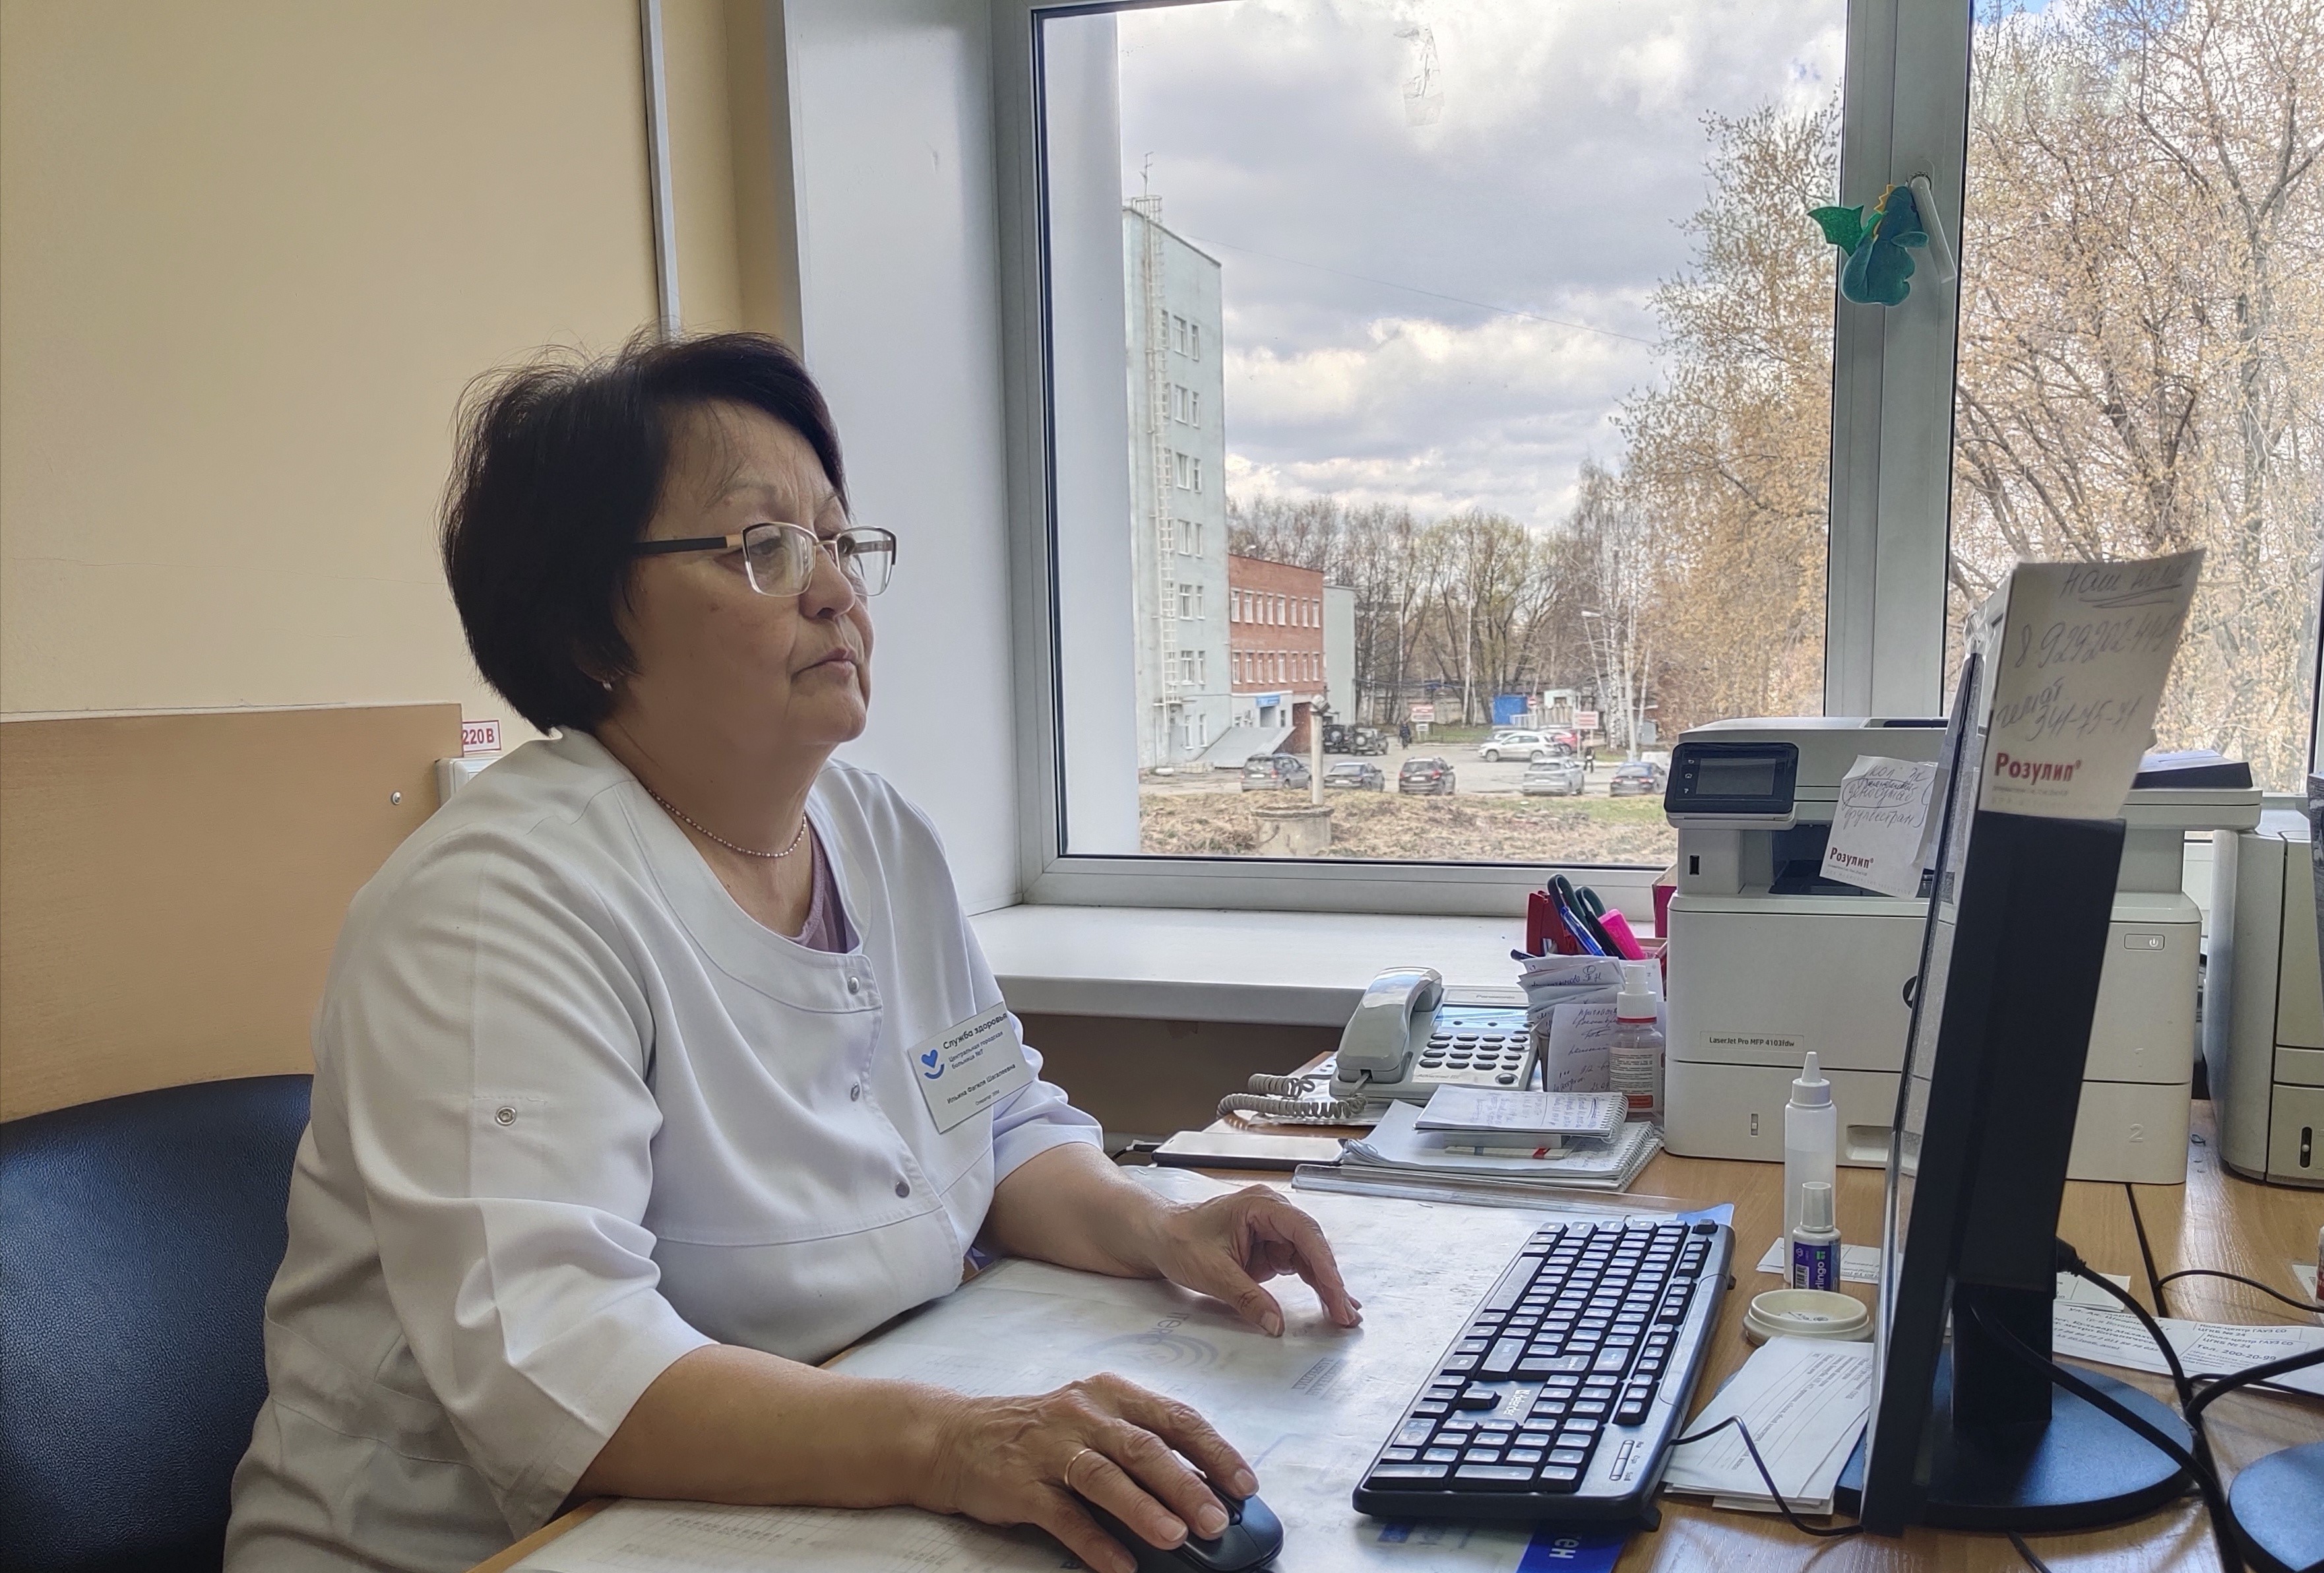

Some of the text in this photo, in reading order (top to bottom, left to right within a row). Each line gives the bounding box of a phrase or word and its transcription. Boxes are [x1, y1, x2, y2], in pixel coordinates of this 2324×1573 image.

[943, 1012, 1008, 1050] Служба здоровья
[949, 1031, 1003, 1062] Центральная городская
[1709, 1037, 1737, 1045] LaserJet
[1765, 1039, 1795, 1047] 4103fdw
[952, 1054, 976, 1070] больница
[947, 1090, 968, 1105] Ильина
[2197, 1344, 2218, 1353] Тел.
[2222, 1349, 2277, 1361] 200-20-99
[1503, 1394, 1528, 1416] defender
